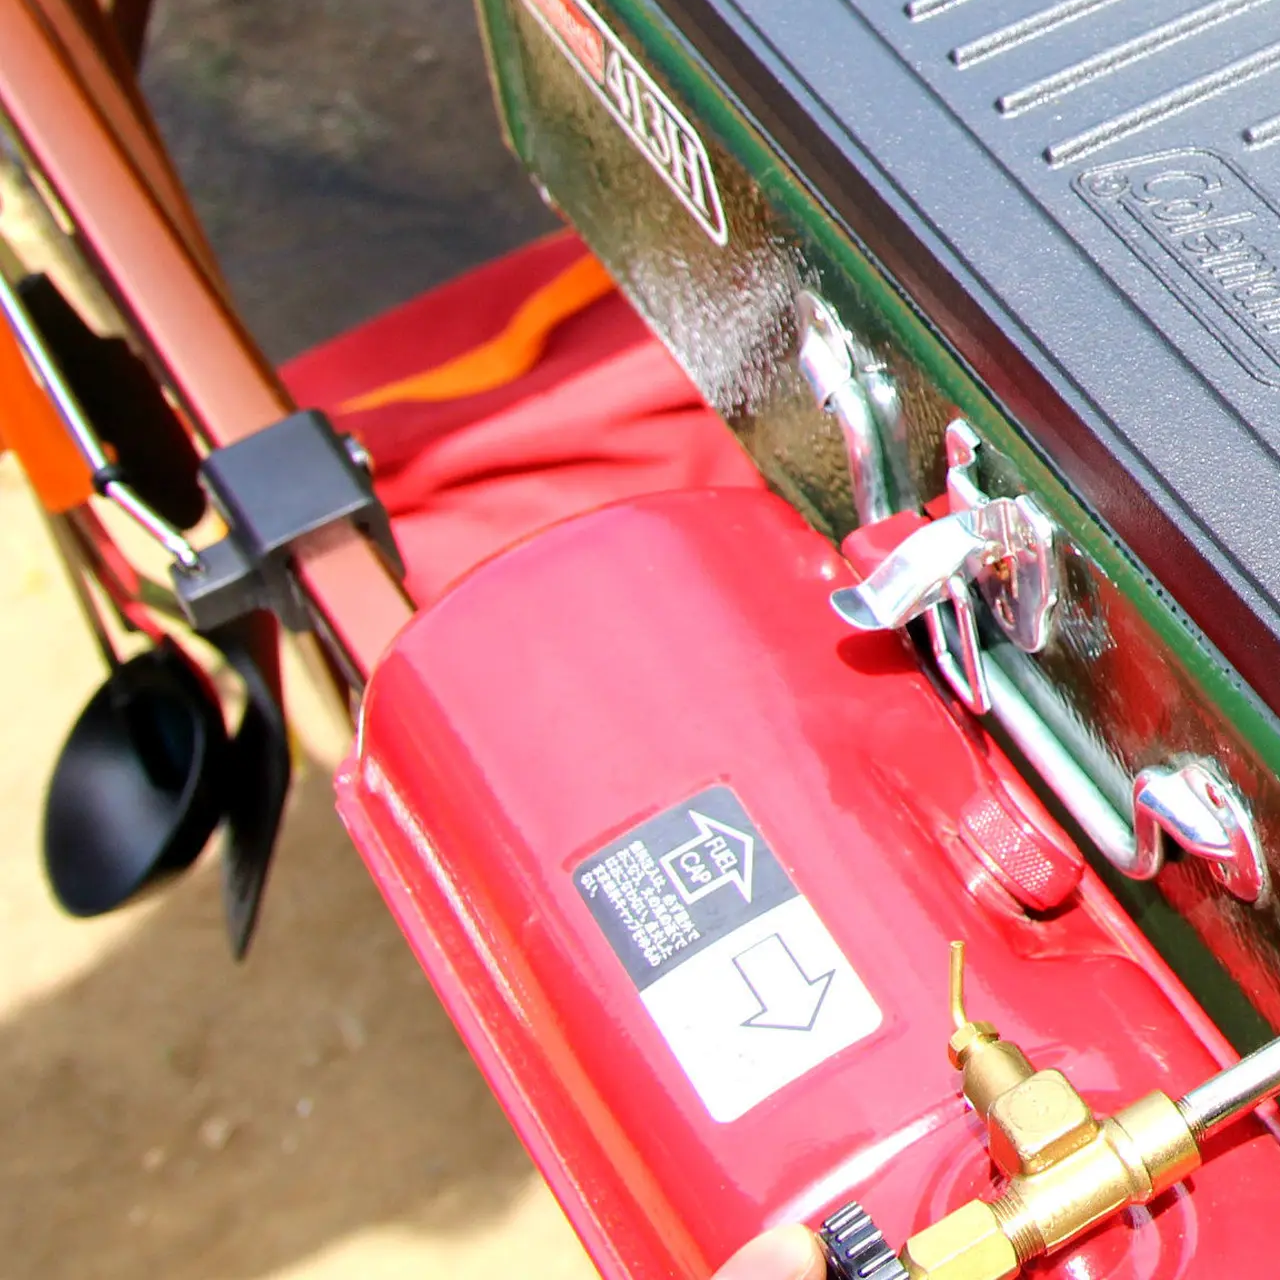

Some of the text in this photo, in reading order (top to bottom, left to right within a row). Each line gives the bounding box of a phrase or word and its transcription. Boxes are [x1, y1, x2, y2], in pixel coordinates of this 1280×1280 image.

[605, 50, 713, 220] 413H
[680, 851, 712, 884] CAP
[704, 835, 741, 875] FUEL
